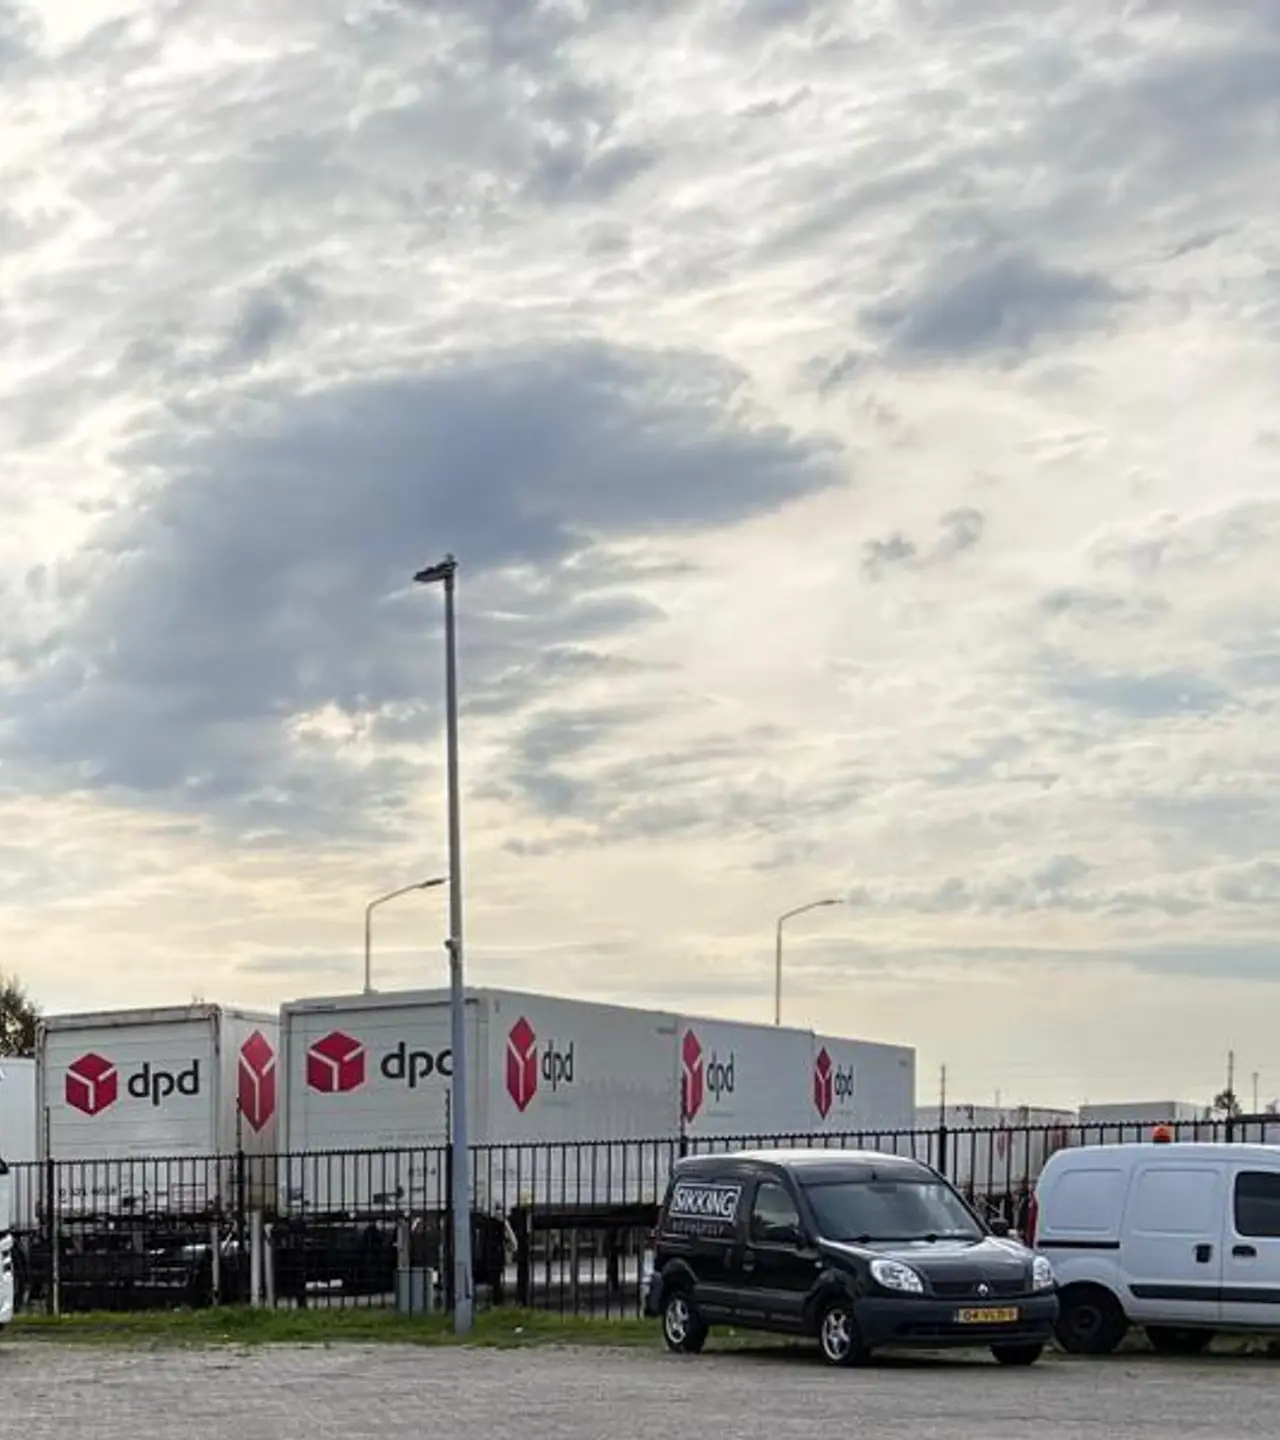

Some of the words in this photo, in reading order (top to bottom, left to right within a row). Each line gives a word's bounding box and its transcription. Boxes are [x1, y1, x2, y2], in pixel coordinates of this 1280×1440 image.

[127, 1058, 200, 1105] dpd
[542, 1041, 574, 1091] dpd
[706, 1051, 734, 1103] dpd
[834, 1065, 854, 1103] dpd
